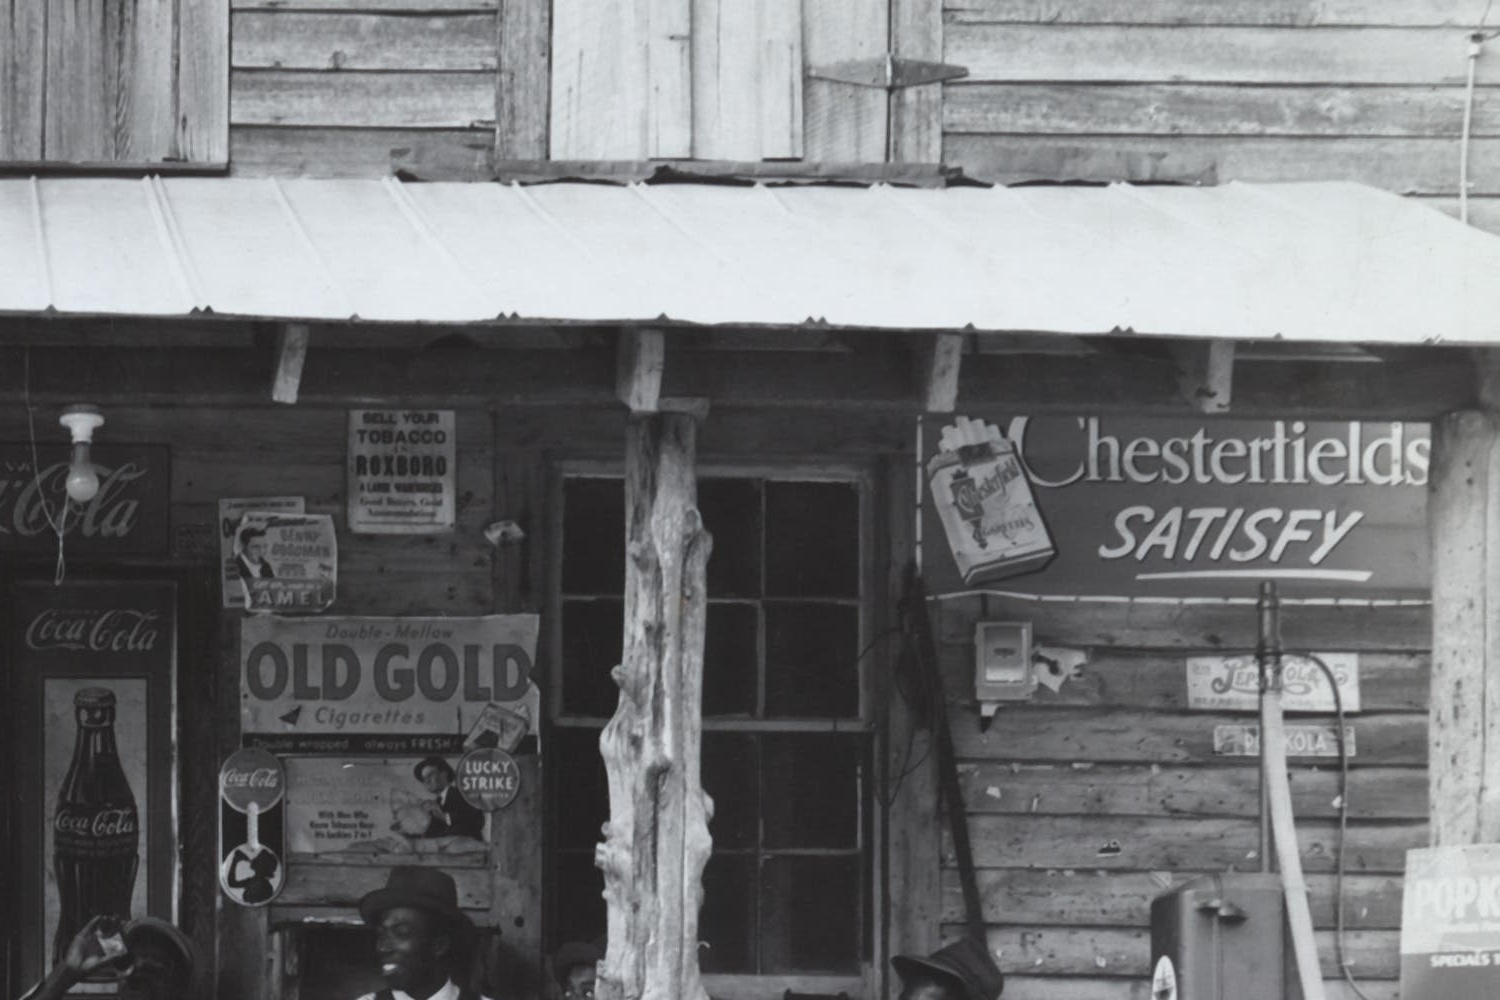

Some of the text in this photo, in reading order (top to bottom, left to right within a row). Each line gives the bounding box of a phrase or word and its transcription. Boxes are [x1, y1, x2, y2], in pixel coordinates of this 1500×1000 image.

[403, 412, 439, 424] YOUR
[356, 429, 447, 444] TOBACCO
[356, 455, 447, 477] ROXBORO
[1099, 506, 1364, 564] SATISFY
[257, 590, 328, 606] AMEL
[247, 641, 532, 702] OLD GOLD
[315, 705, 426, 729] Cigarettes
[298, 739, 348, 750] wrapped
[363, 739, 407, 751] always
[465, 760, 510, 775] LUCKY
[462, 776, 513, 791] STRIKE
